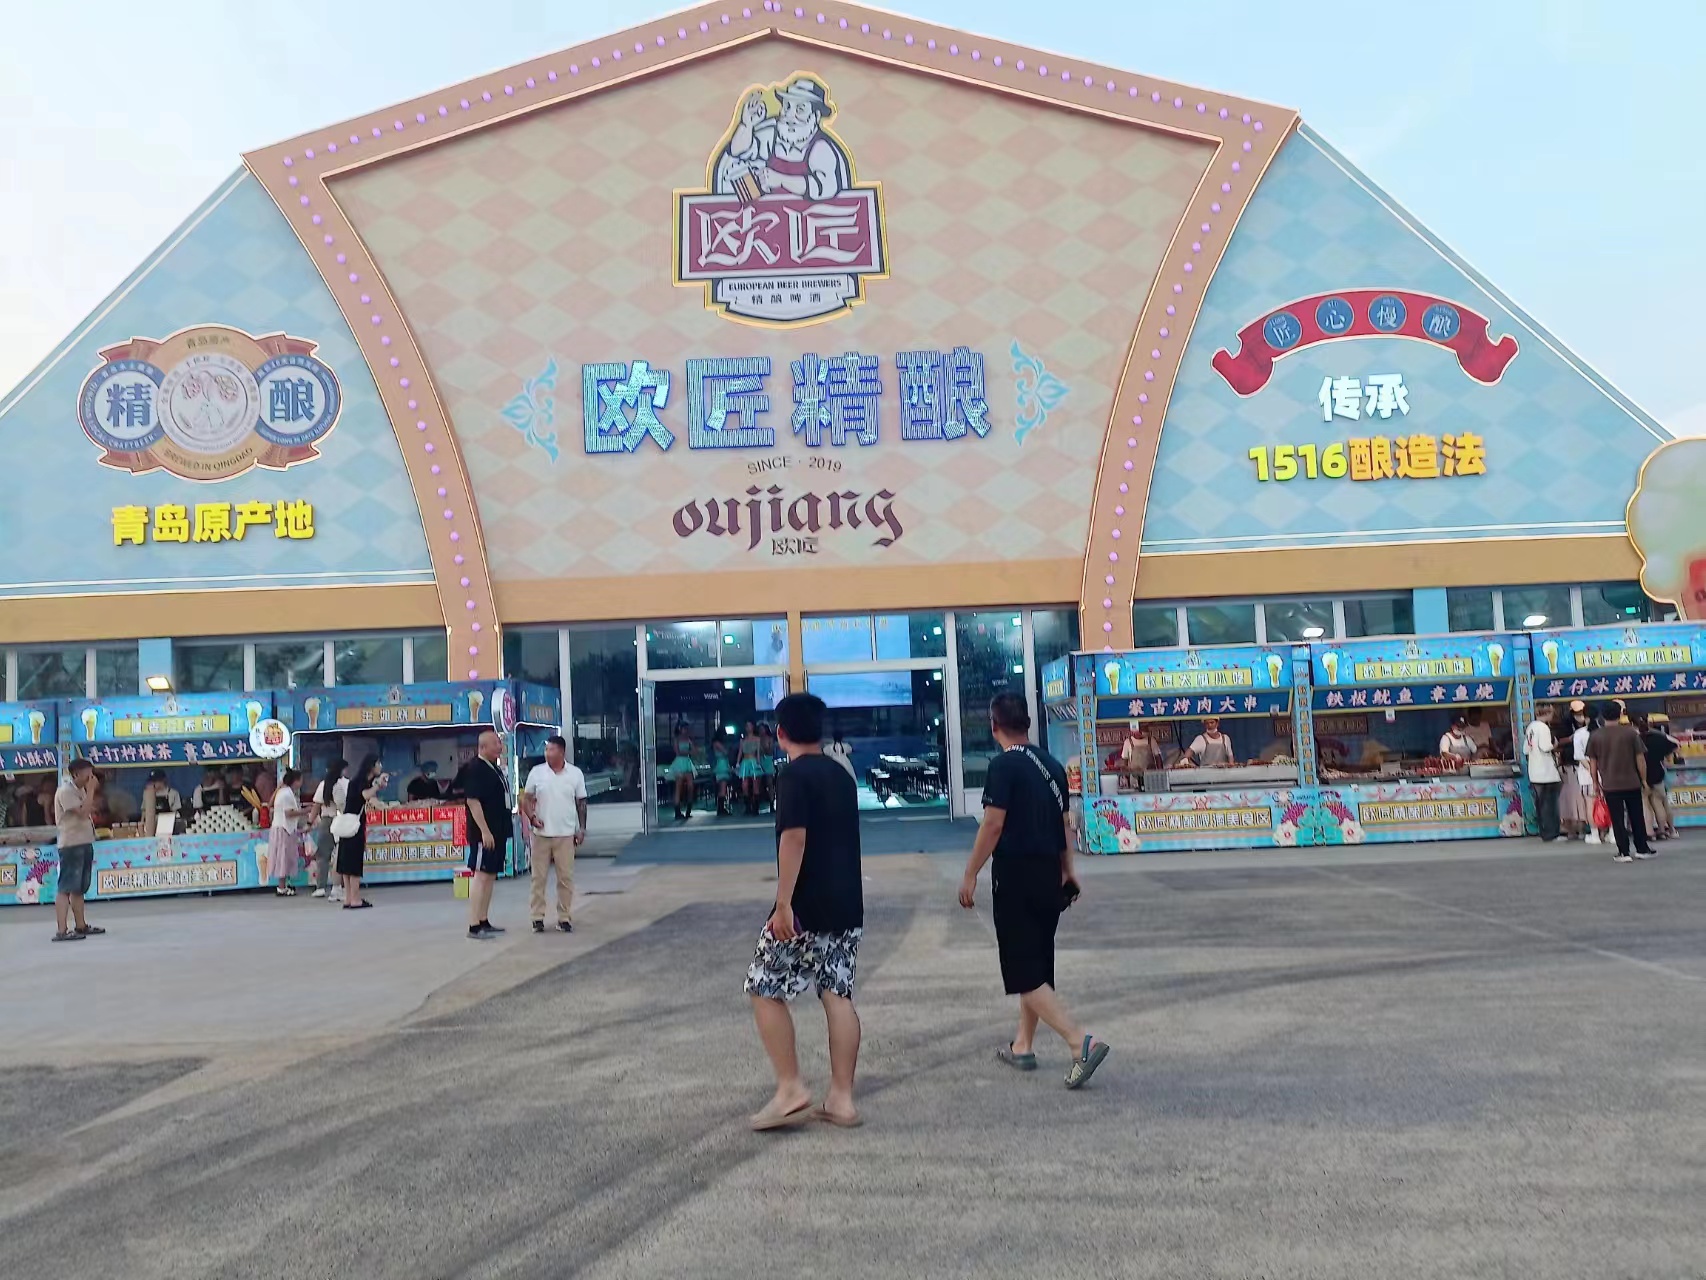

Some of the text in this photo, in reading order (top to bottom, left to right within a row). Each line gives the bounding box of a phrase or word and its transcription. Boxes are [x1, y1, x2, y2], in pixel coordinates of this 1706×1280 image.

[695, 200, 866, 268] 欧匠
[728, 278, 842, 291] EUROPEAN BEER BREWERS
[751, 292, 821, 305] 精酿啤酒
[106, 382, 152, 428] 精
[269, 377, 315, 423] 酿
[581, 346, 991, 454] 欧匠精酿
[1318, 373, 1411, 422] 传承
[213, 448, 253, 470] QINGDAO
[747, 455, 843, 475] SINCE 2019
[1249, 432, 1487, 481] 1516酿造法
[111, 498, 315, 546] 青岛原产地
[672, 484, 905, 551] oujiang
[771, 537, 819, 556] 欧匠
[1128, 695, 1258, 717] 蒙古烤肉大串
[88, 742, 172, 762] 手打柠檬茶
